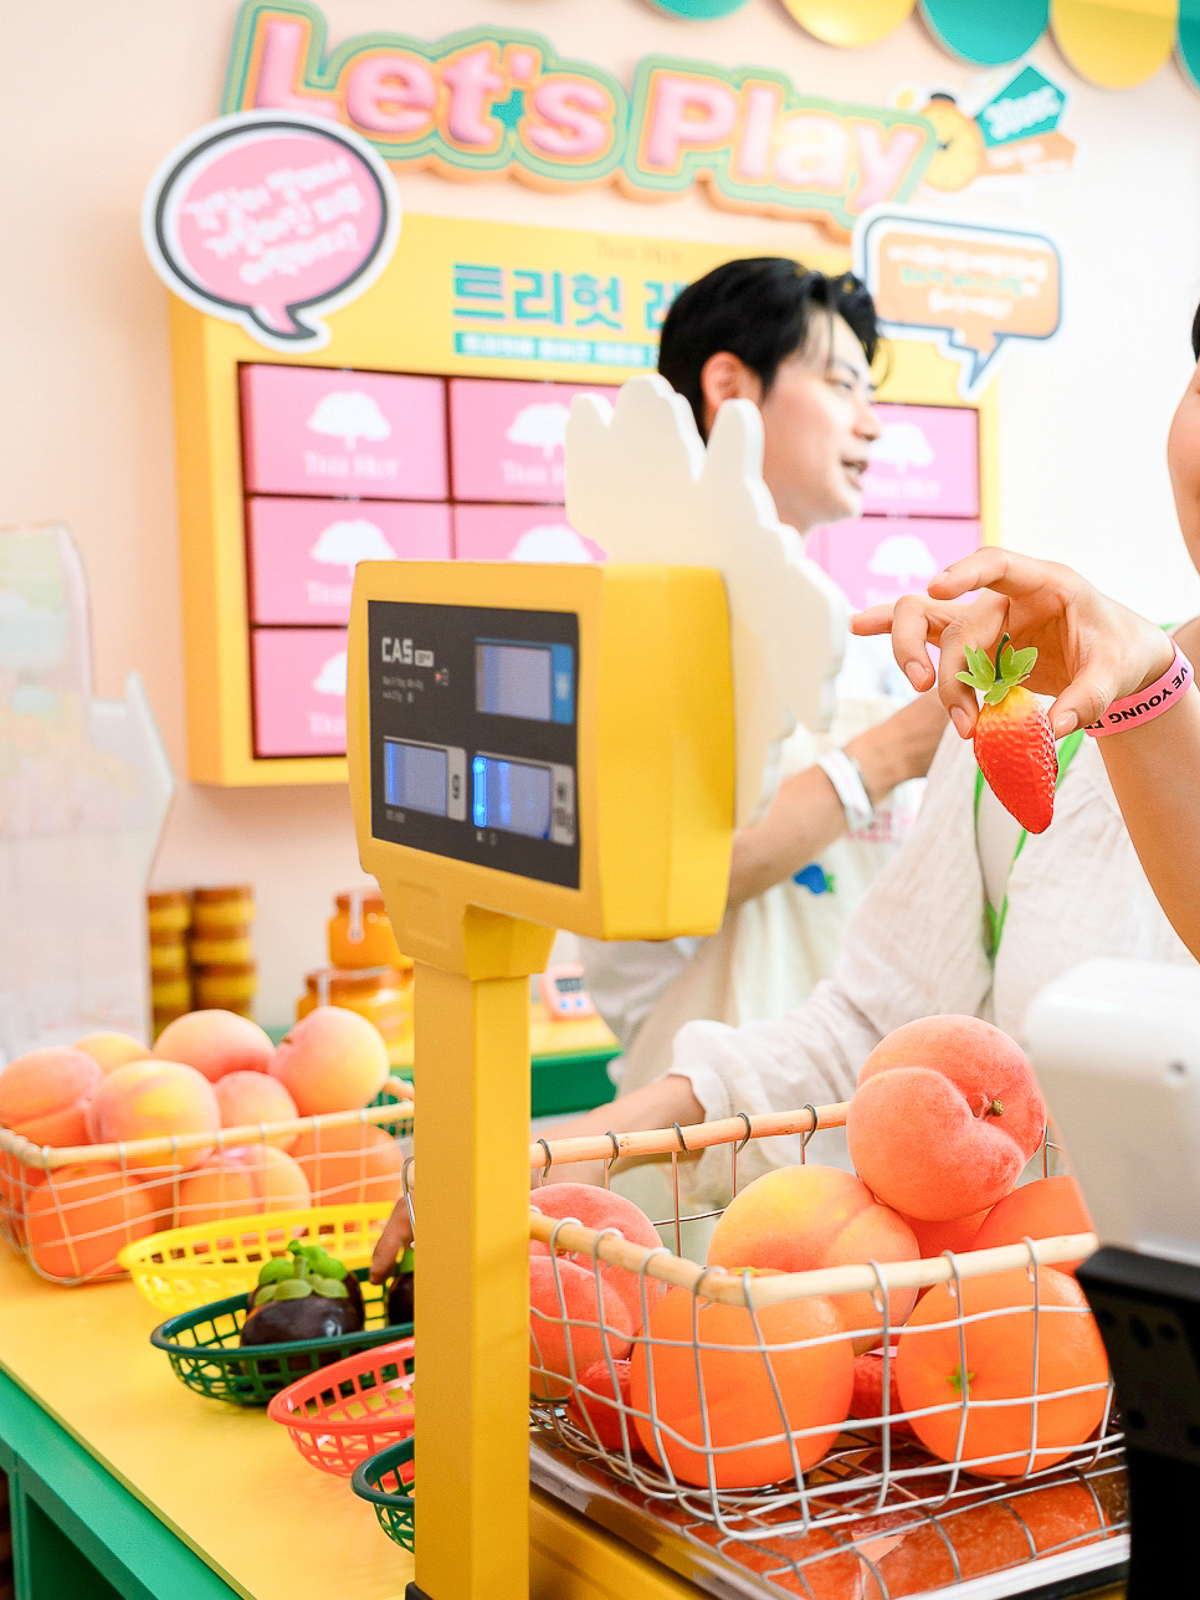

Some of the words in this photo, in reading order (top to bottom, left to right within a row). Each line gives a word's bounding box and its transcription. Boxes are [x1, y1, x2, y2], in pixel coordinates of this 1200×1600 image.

[254, 19, 611, 155] Let's
[646, 74, 922, 207] Play
[452, 262, 621, 329] 트리헛
[381, 637, 414, 665] CAS
[1108, 688, 1174, 724] YOUNG
